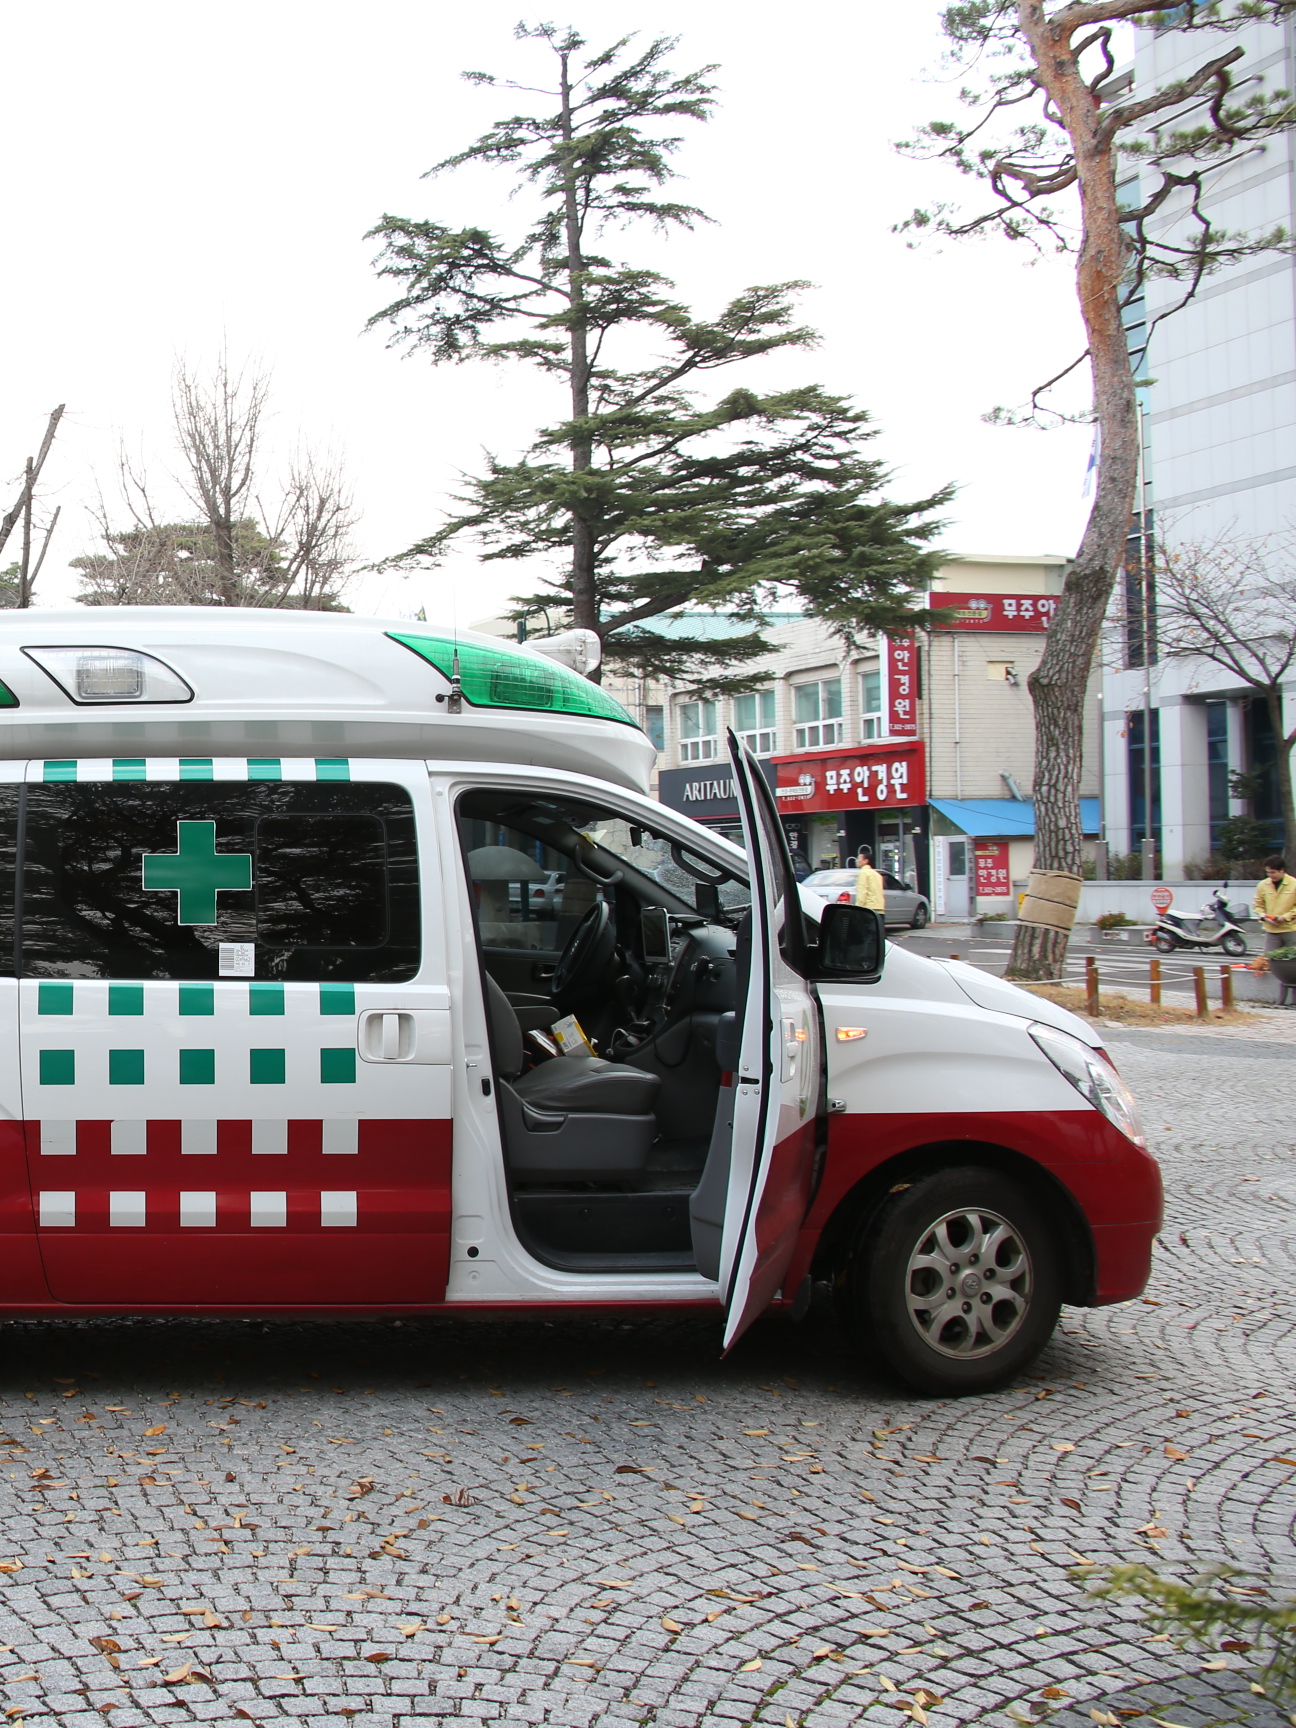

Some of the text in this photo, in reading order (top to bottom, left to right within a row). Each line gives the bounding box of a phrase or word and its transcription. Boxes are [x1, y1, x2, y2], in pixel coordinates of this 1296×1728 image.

[893, 650, 911, 719] 안경원
[825, 761, 908, 802] 무주안경원
[978, 858, 994, 868] 무주
[978, 868, 1008, 883] 안경원
